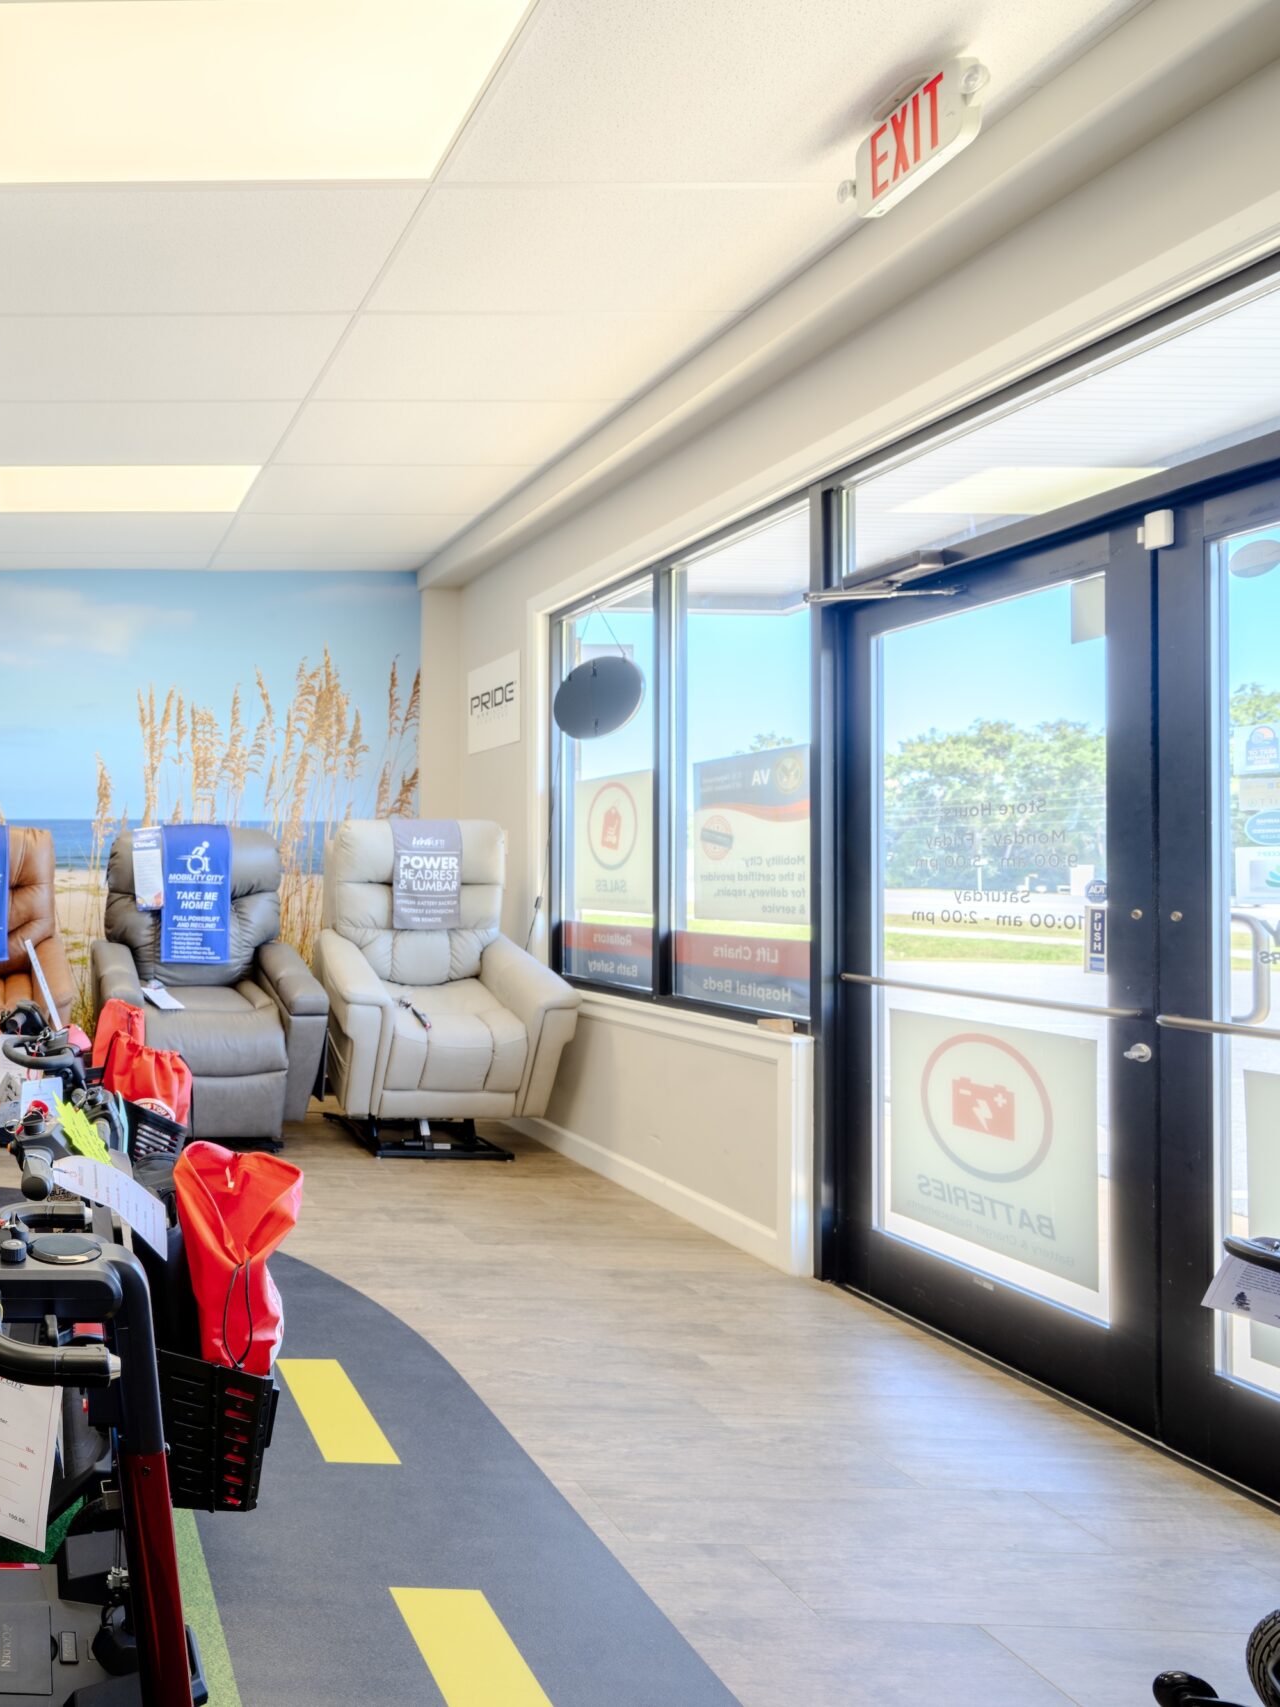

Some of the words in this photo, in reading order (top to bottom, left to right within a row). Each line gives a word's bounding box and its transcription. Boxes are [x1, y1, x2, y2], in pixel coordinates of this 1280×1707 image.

[871, 71, 943, 199] EXIT
[470, 681, 515, 716] PRIDE
[400, 856, 458, 869] POWER
[400, 869, 458, 880] HEADREST
[398, 880, 408, 890] &
[413, 881, 458, 891] LUMBAR
[1088, 885, 1106, 894] ADT
[176, 891, 202, 900] TAKE
[204, 892, 218, 900] ME
[181, 901, 213, 910] HOME!
[1094, 912, 1102, 951] PUSH
[6, 1378, 24, 1389] CITY
